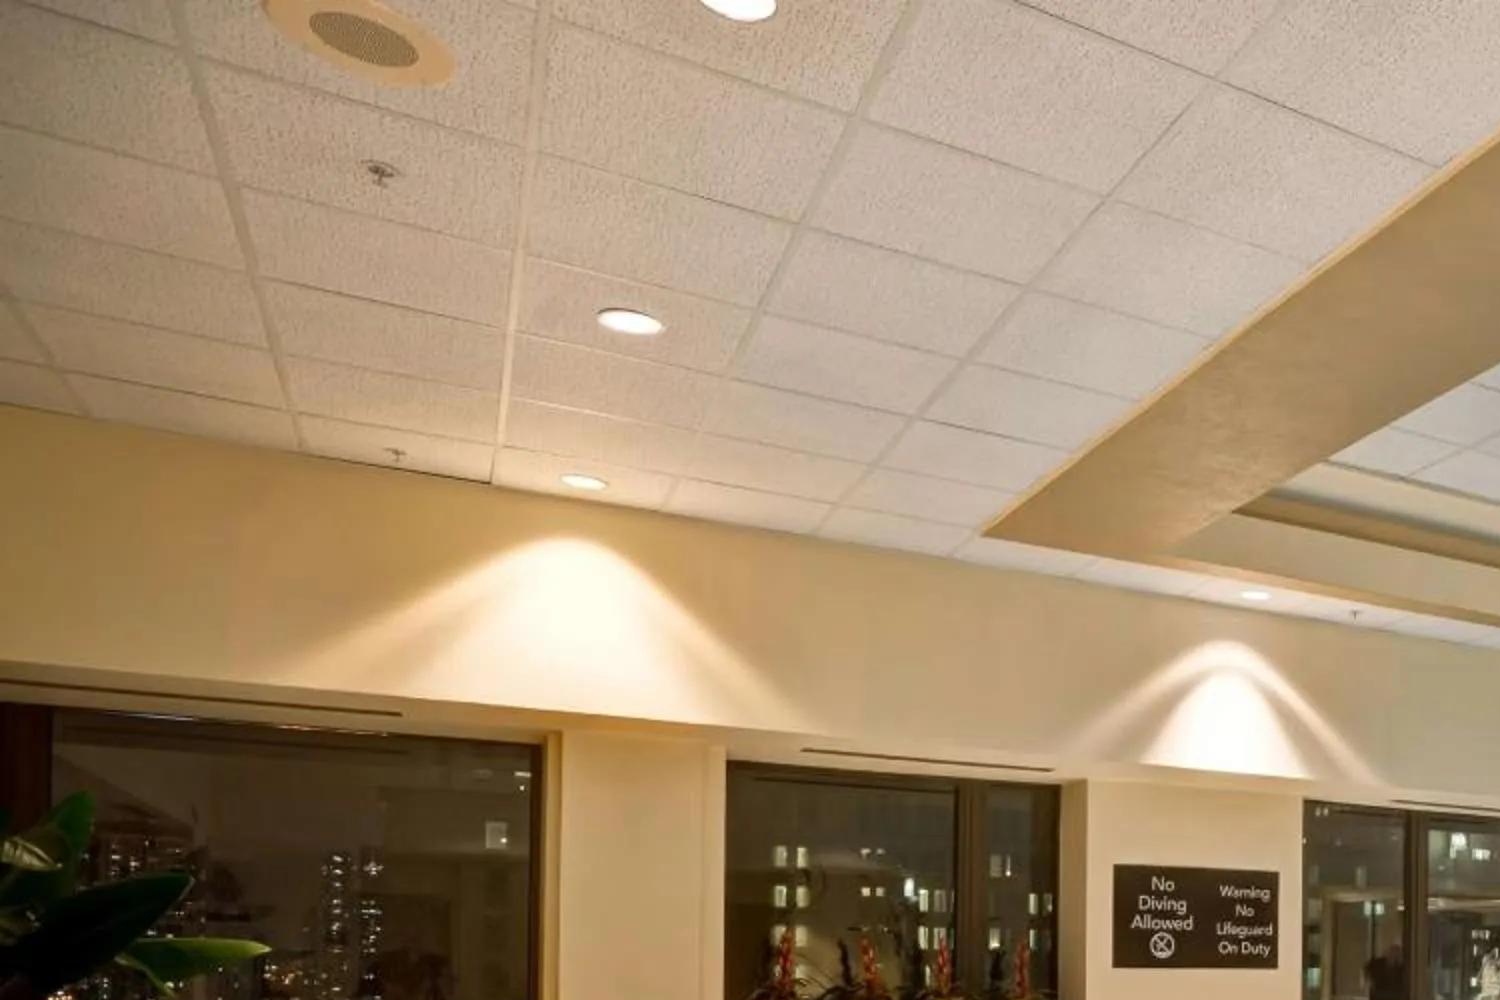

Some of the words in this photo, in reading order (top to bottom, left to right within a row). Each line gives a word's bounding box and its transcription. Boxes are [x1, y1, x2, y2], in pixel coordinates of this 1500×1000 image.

[1151, 876, 1175, 892] No
[1219, 884, 1271, 902] Warning
[1138, 895, 1187, 915] Diving
[1235, 904, 1255, 917] No
[1131, 914, 1194, 931] Allowed
[1216, 922, 1273, 938] Lifeguard
[1218, 941, 1238, 955] On
[1241, 941, 1271, 958] Duty
